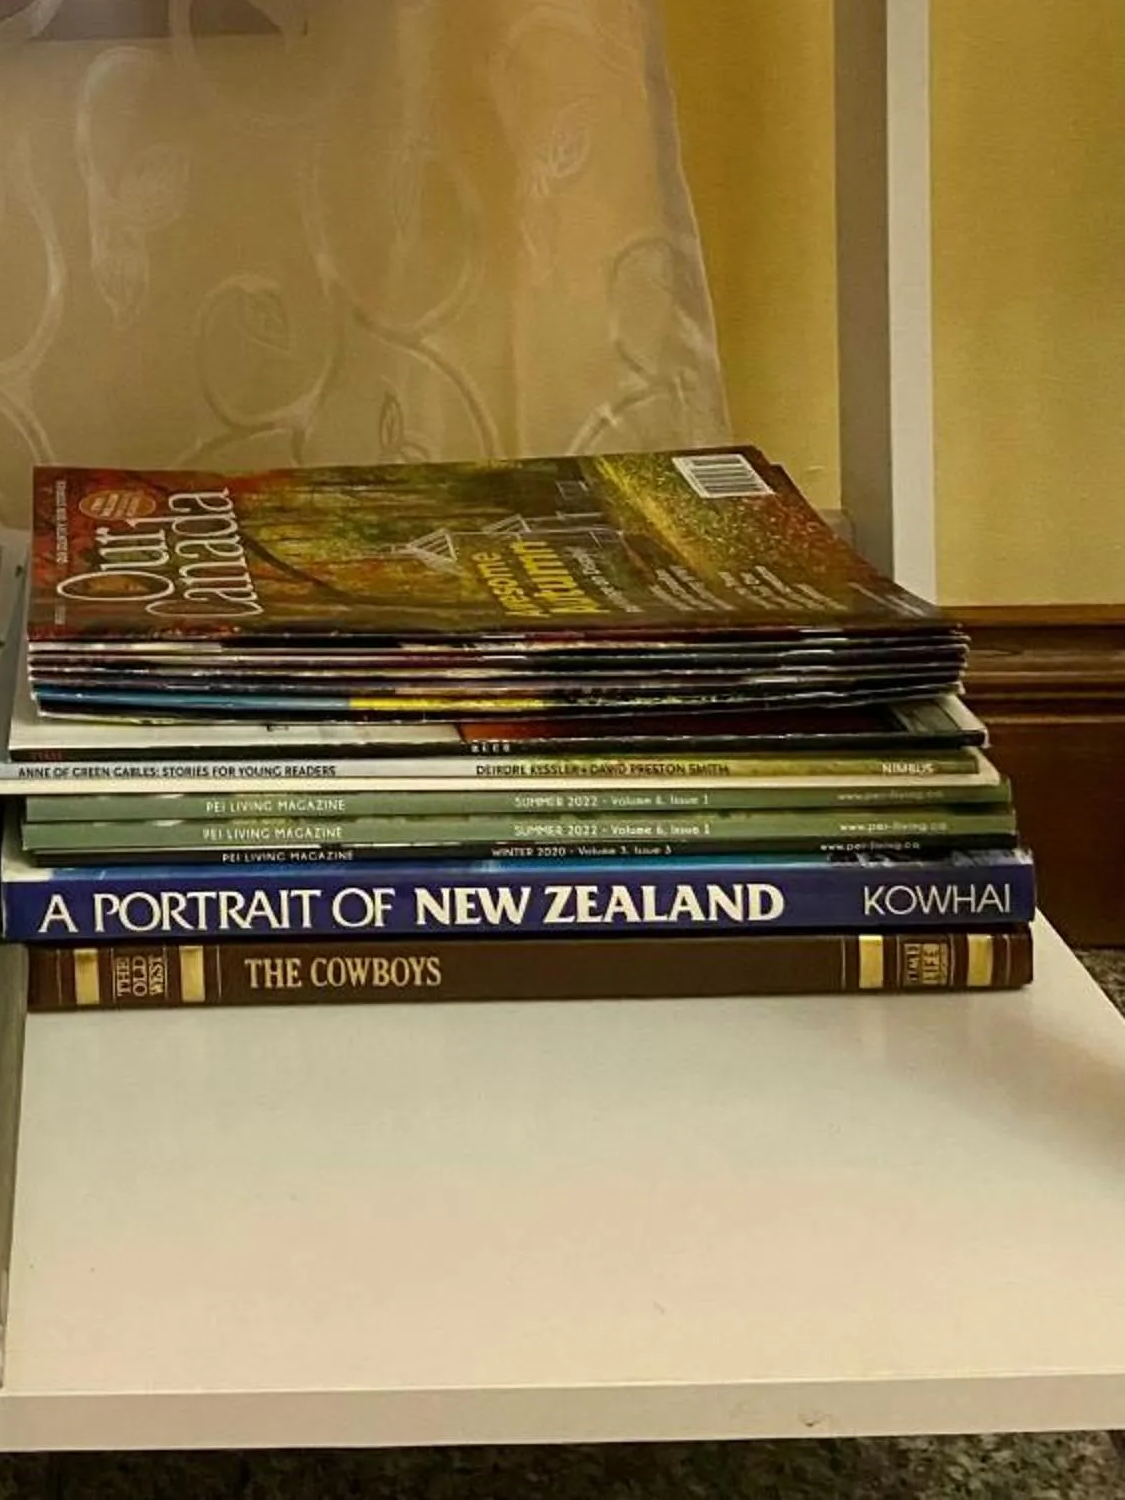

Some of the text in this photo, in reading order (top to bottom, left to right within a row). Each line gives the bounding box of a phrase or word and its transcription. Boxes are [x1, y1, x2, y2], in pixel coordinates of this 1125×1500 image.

[125, 486, 265, 618] Canada
[56, 526, 175, 601] Our
[18, 767, 51, 779] ANNE
[52, 767, 71, 779] OF
[72, 766, 111, 779] GREEN
[162, 766, 210, 778] STORIES
[212, 766, 236, 778] FOR
[238, 765, 282, 778] YOUNG
[284, 765, 337, 778] READERS
[476, 762, 730, 776] DEIRDRE KESSLER DAVID PRESTON SMITH
[882, 762, 935, 775] NIMBUS
[206, 799, 346, 813] PEI LIVING MAGAZINE
[514, 796, 565, 809] SUMMER
[611, 794, 652, 806] Volume
[670, 793, 699, 805] Issue
[203, 826, 345, 840] PEI LIVING MAGAZINE
[514, 824, 565, 837] SUMMER
[610, 823, 653, 836] Volume
[670, 823, 700, 835] Issue
[222, 850, 354, 863] PEI LIVING MAGAZINE
[491, 847, 534, 857] WINTER
[577, 846, 616, 856] Volume
[863, 883, 1012, 917] KOWHAI
[37, 883, 786, 934] A PORTRAIT OF NEW ZEALAND
[115, 955, 131, 997] THE
[132, 955, 147, 997] OLD
[148, 954, 164, 997] WEST
[244, 956, 442, 989] THE COWBOYS
